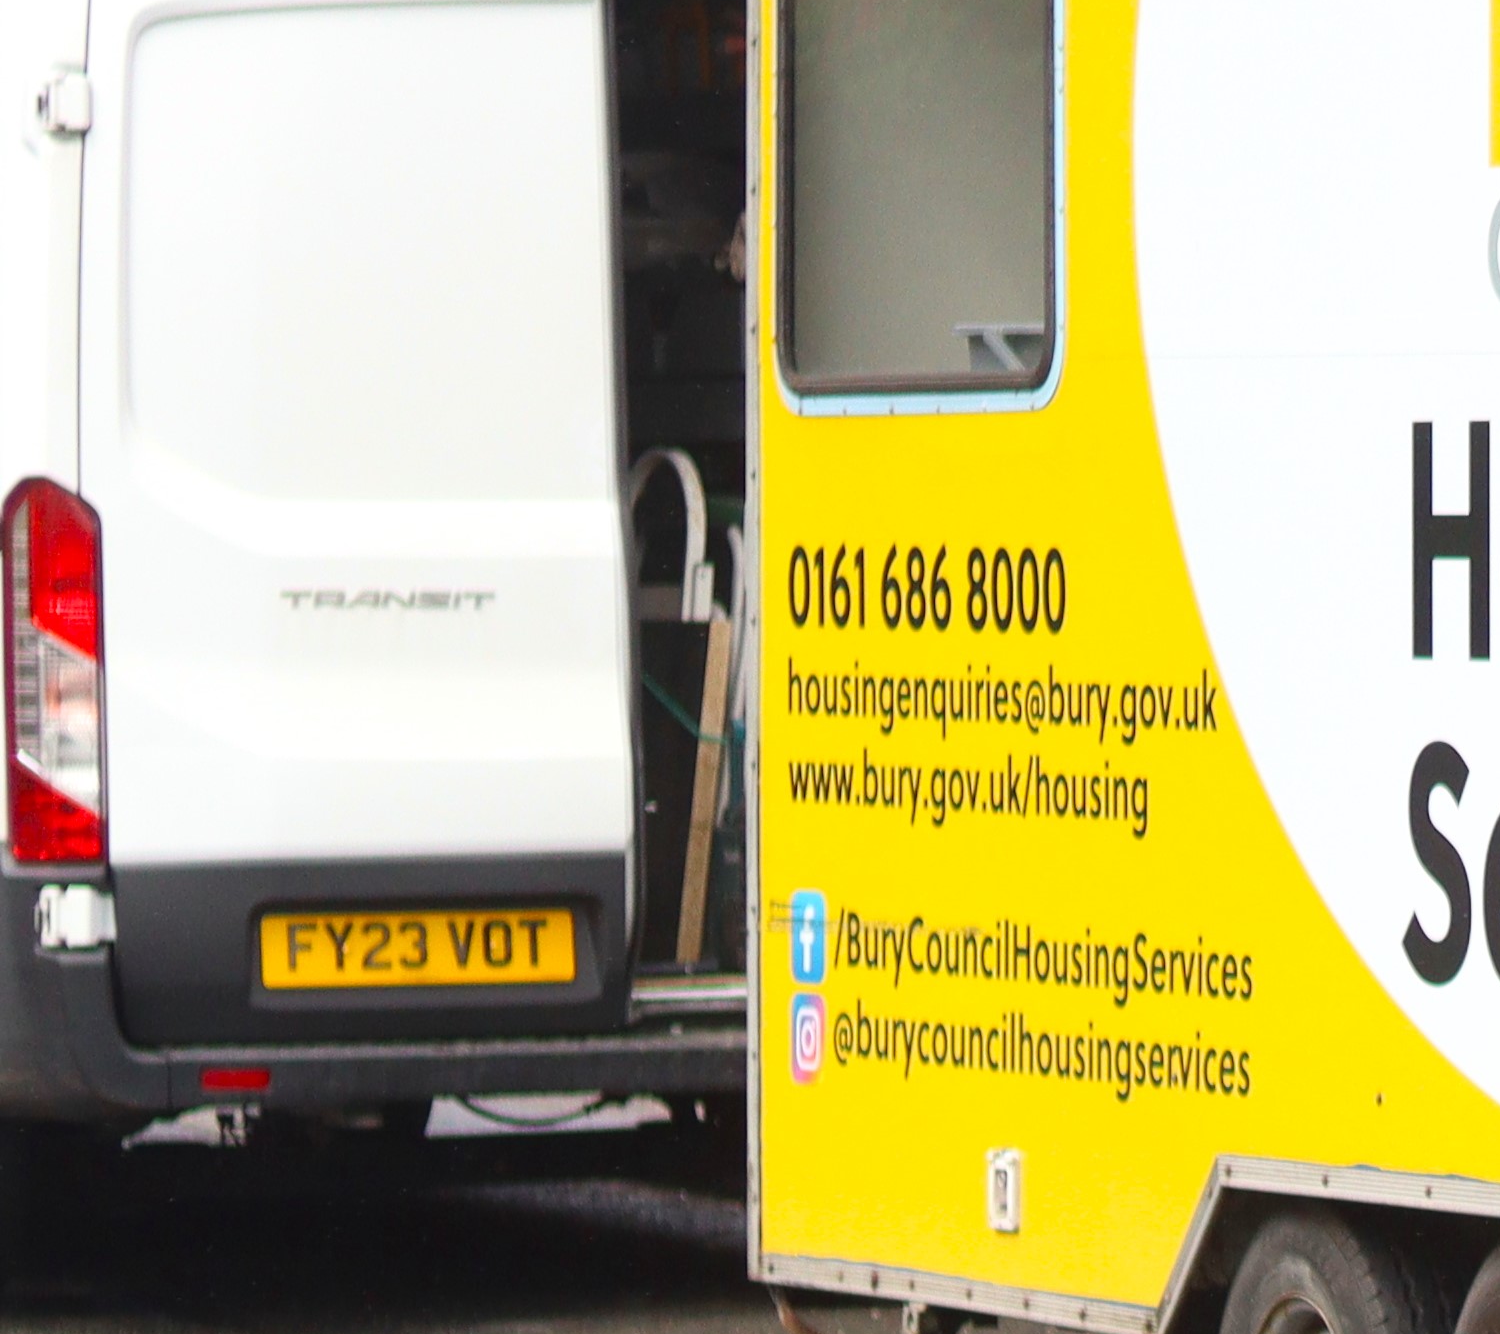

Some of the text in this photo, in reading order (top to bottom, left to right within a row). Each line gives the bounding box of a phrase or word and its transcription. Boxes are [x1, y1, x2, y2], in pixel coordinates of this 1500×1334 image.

[279, 588, 497, 610] TRANSIT
[790, 545, 1065, 633] 0161 686 8000
[789, 659, 1215, 745] housingenquiries@bury.gov.uk
[790, 750, 1147, 838] www.bury.gov.uk/housing
[286, 918, 549, 971] FY23 VOT
[834, 908, 1252, 1007] /BuryCouncilHousingServices
[834, 999, 1250, 1101] @burycouncilhousingservices
